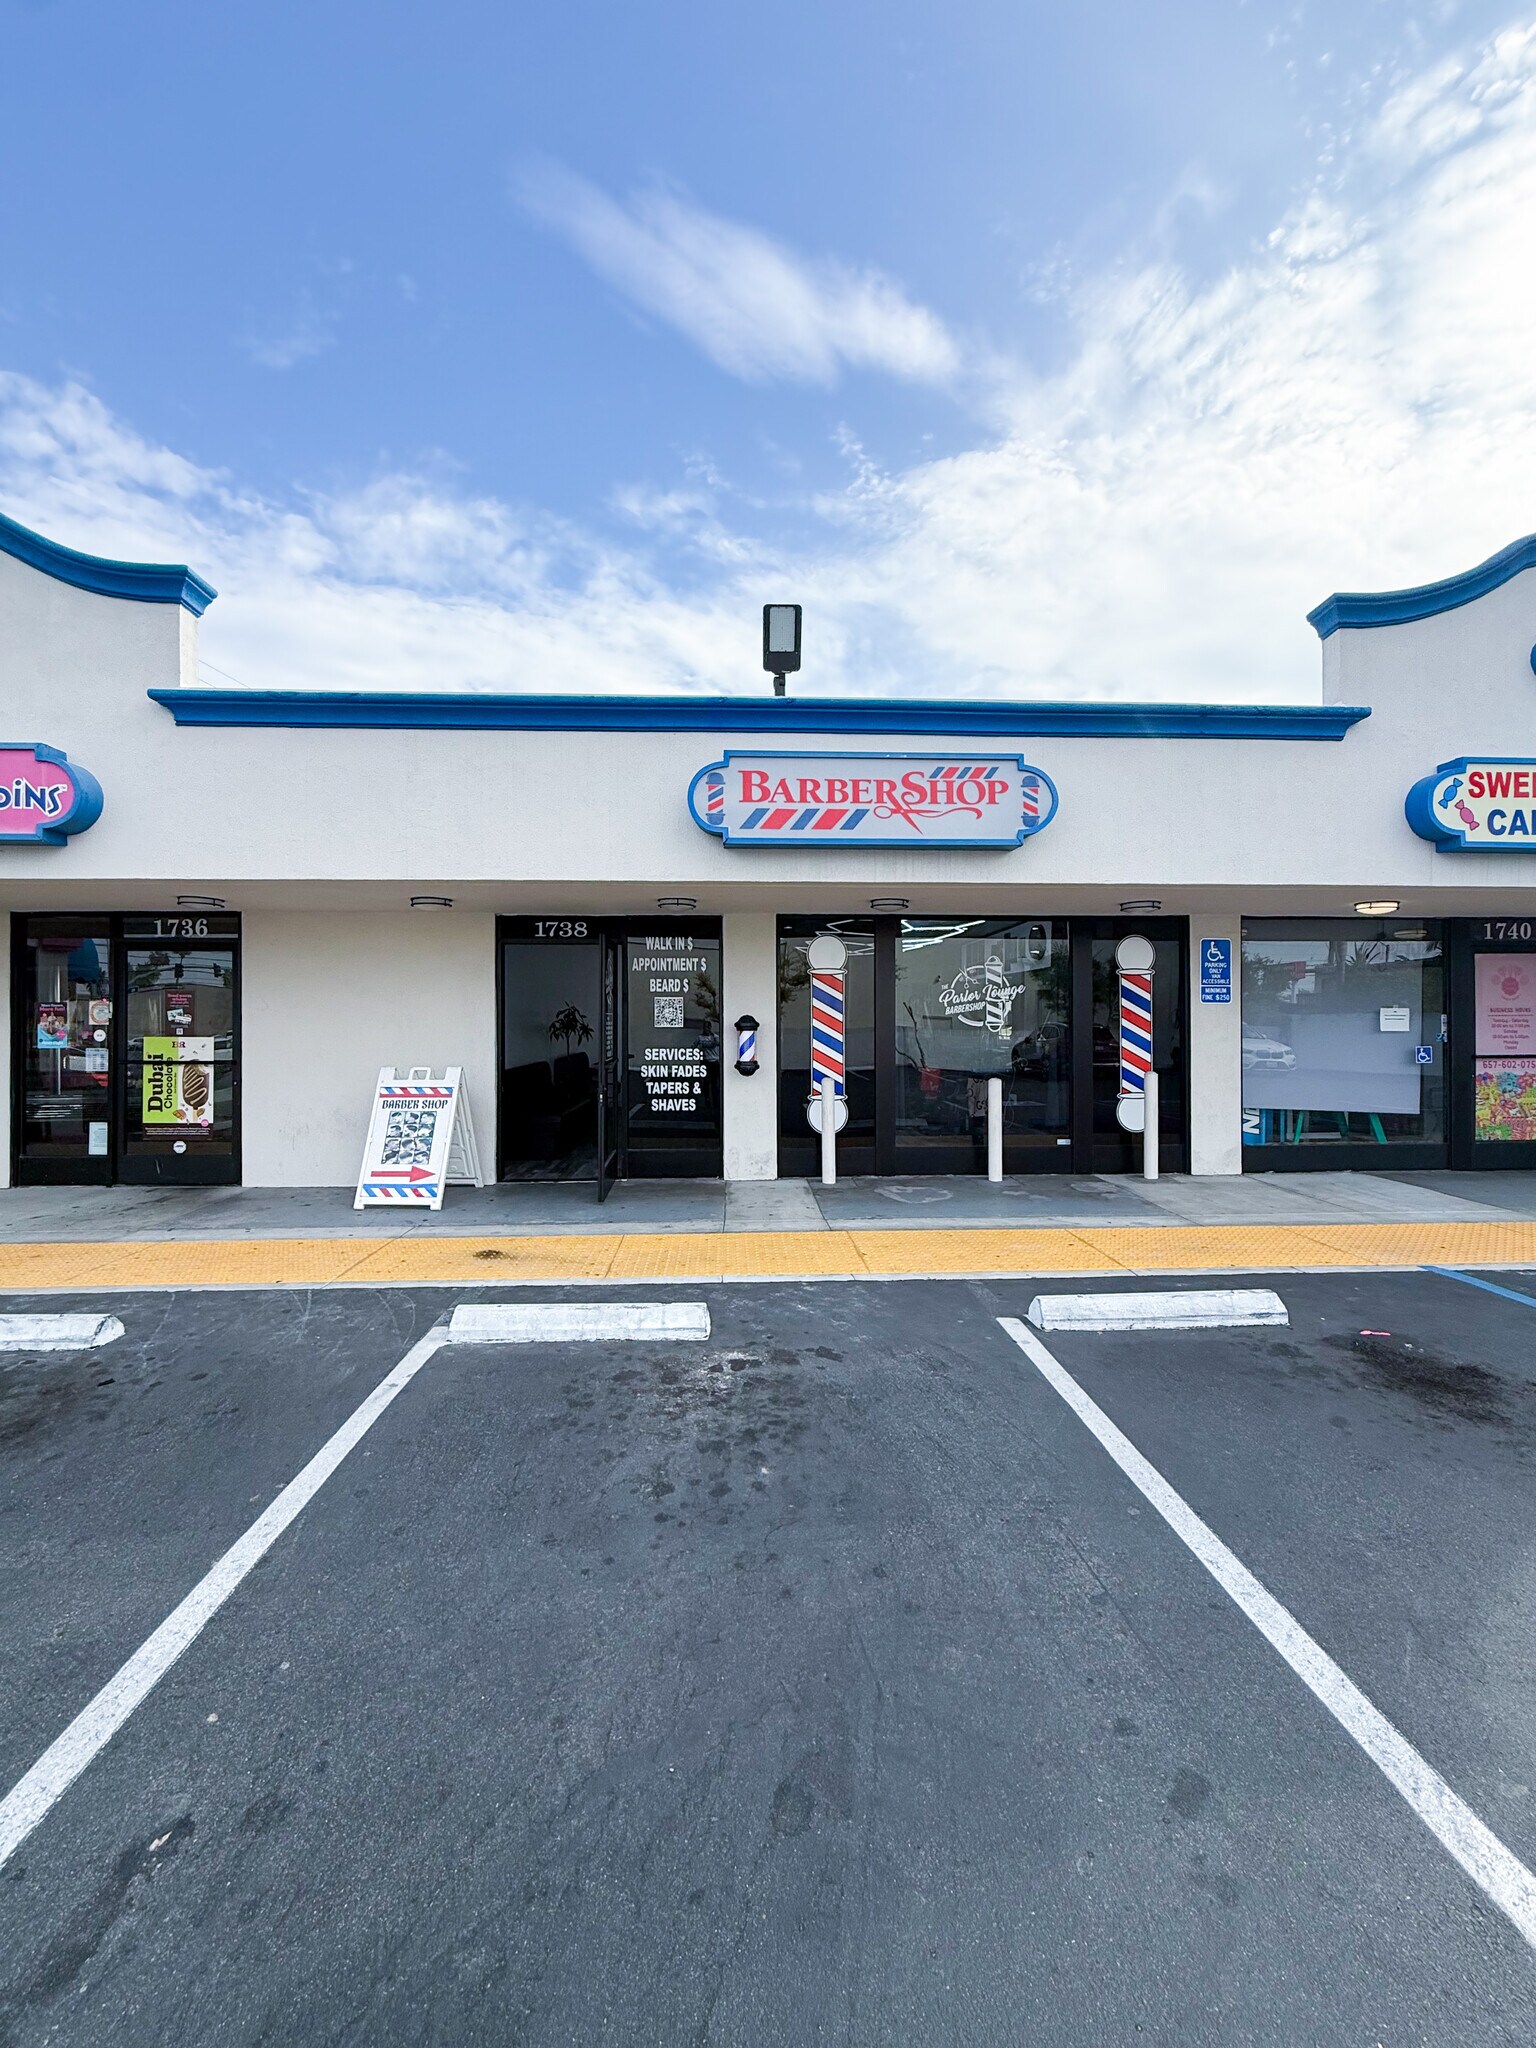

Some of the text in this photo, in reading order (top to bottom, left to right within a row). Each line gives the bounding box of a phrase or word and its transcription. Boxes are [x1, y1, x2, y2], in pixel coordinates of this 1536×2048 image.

[1468, 771, 1536, 799] SWE
[1487, 808, 1536, 836] CA
[153, 919, 209, 937] 1736
[534, 921, 588, 938] 1738
[1483, 922, 1532, 940] 1740
[645, 936, 694, 952] WALK IN $
[632, 957, 707, 973] APPOINTMENT $
[649, 978, 690, 994] BEARD $
[938, 988, 981, 1008] Parlor
[945, 1001, 986, 1016] BARBERSHOP
[644, 1048, 704, 1061] SERVICES:
[640, 1065, 707, 1078] SKIN FADES
[147, 1053, 164, 1113] Dubai
[646, 1081, 702, 1094] TAPERS &
[382, 1099, 448, 1109] BARBER SHOP
[651, 1098, 697, 1112] SHAVES
